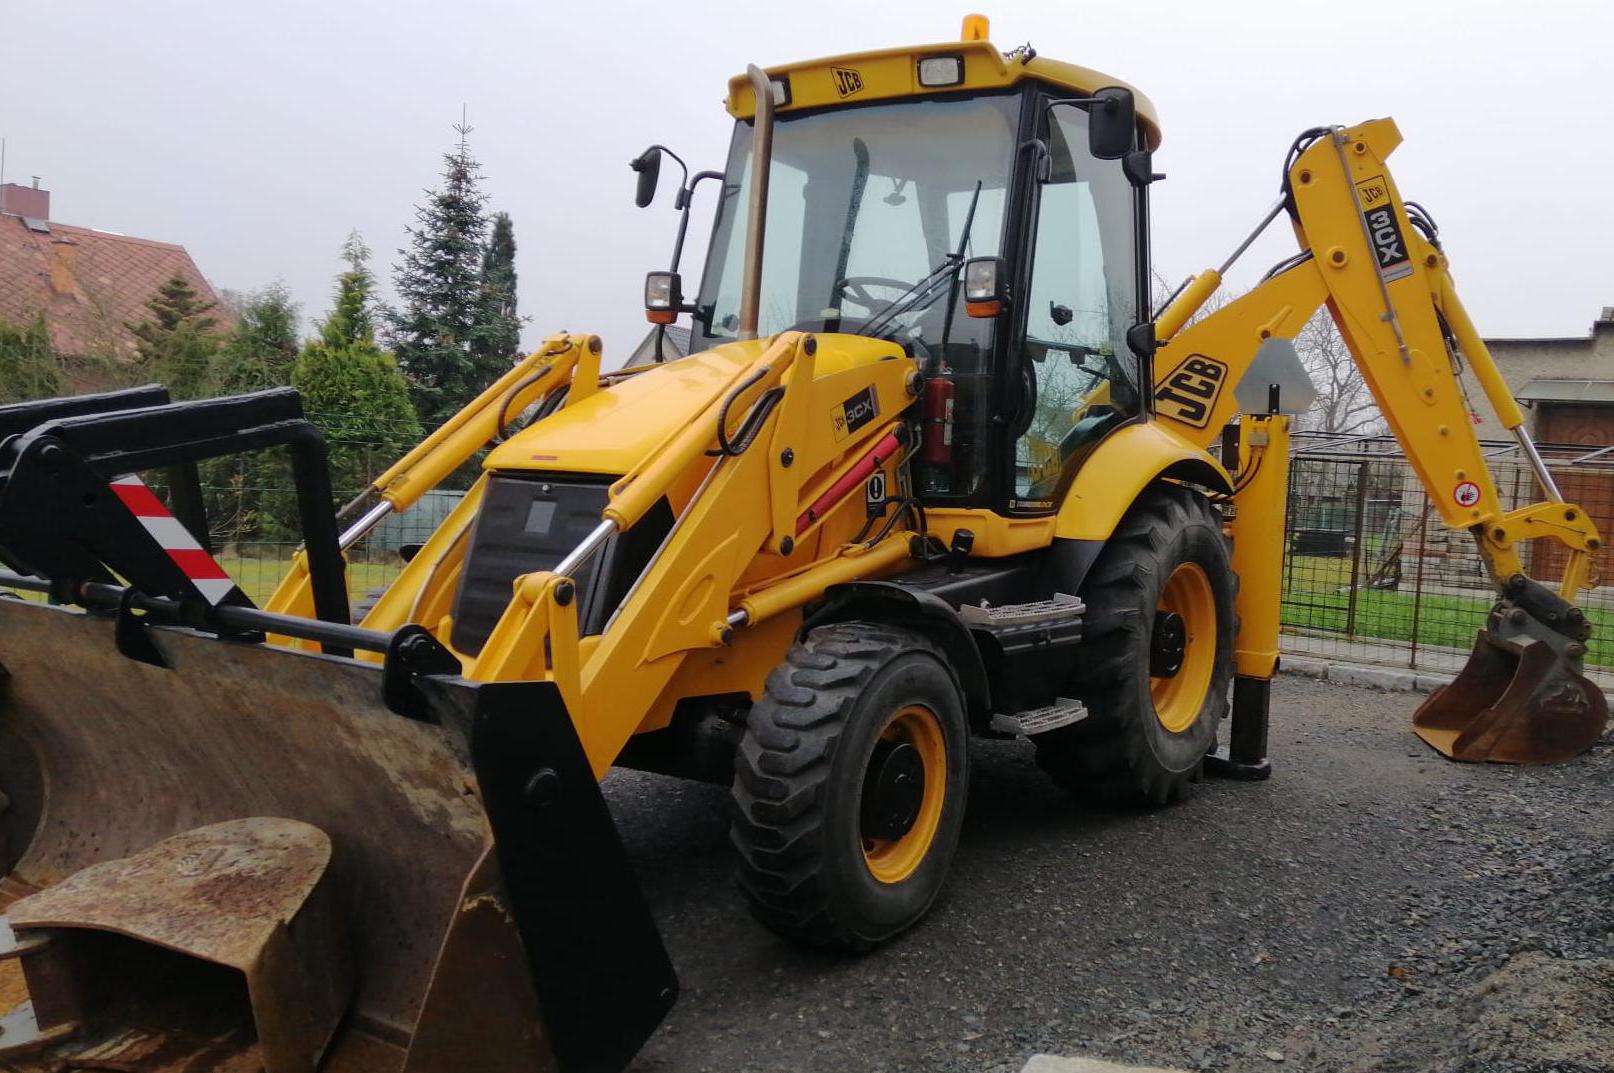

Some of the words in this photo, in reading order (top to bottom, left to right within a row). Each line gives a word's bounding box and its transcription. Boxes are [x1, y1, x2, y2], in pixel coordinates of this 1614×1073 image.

[836, 70, 862, 95] JCB
[1362, 186, 1384, 203] JCB
[1369, 210, 1403, 263] 3CX
[1155, 359, 1222, 421] JCB
[846, 398, 872, 424] 3CX
